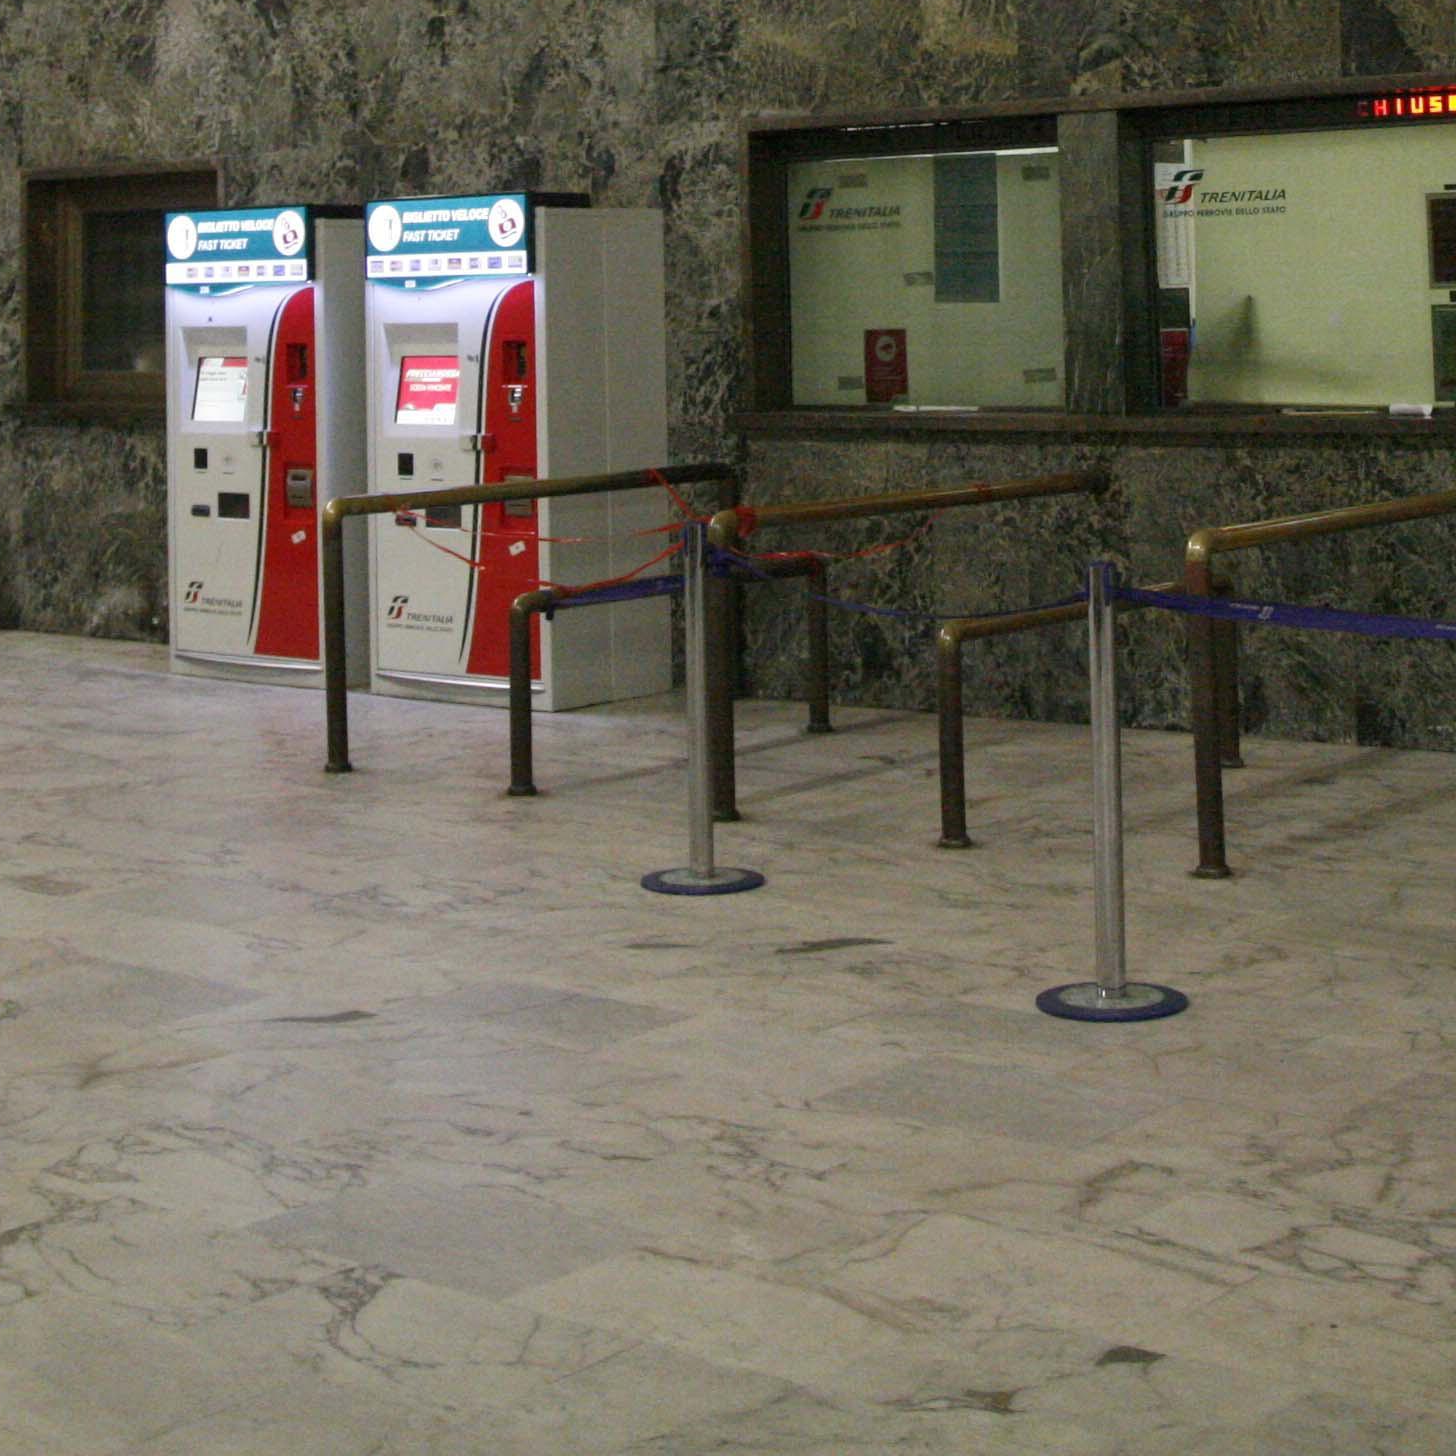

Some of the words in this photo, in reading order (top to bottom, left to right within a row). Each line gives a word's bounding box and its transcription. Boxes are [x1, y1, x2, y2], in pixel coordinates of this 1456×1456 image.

[1200, 189, 1286, 203] TRENITALIA
[402, 209, 451, 223] BIGLIETTO
[451, 207, 490, 221] VELOCE
[830, 205, 901, 219] TRENITALIA
[1235, 207, 1260, 215] DELLO
[1262, 205, 1286, 214] STATO
[197, 221, 241, 234] BIGLIETTO
[241, 218, 275, 232] VELOCE
[403, 230, 427, 243] FAST
[427, 228, 460, 242] TICKET
[197, 239, 219, 251] FAST
[219, 238, 248, 250] TICKET
[201, 596, 243, 608] TRENITALIA
[407, 612, 454, 624] TRENITALIA
